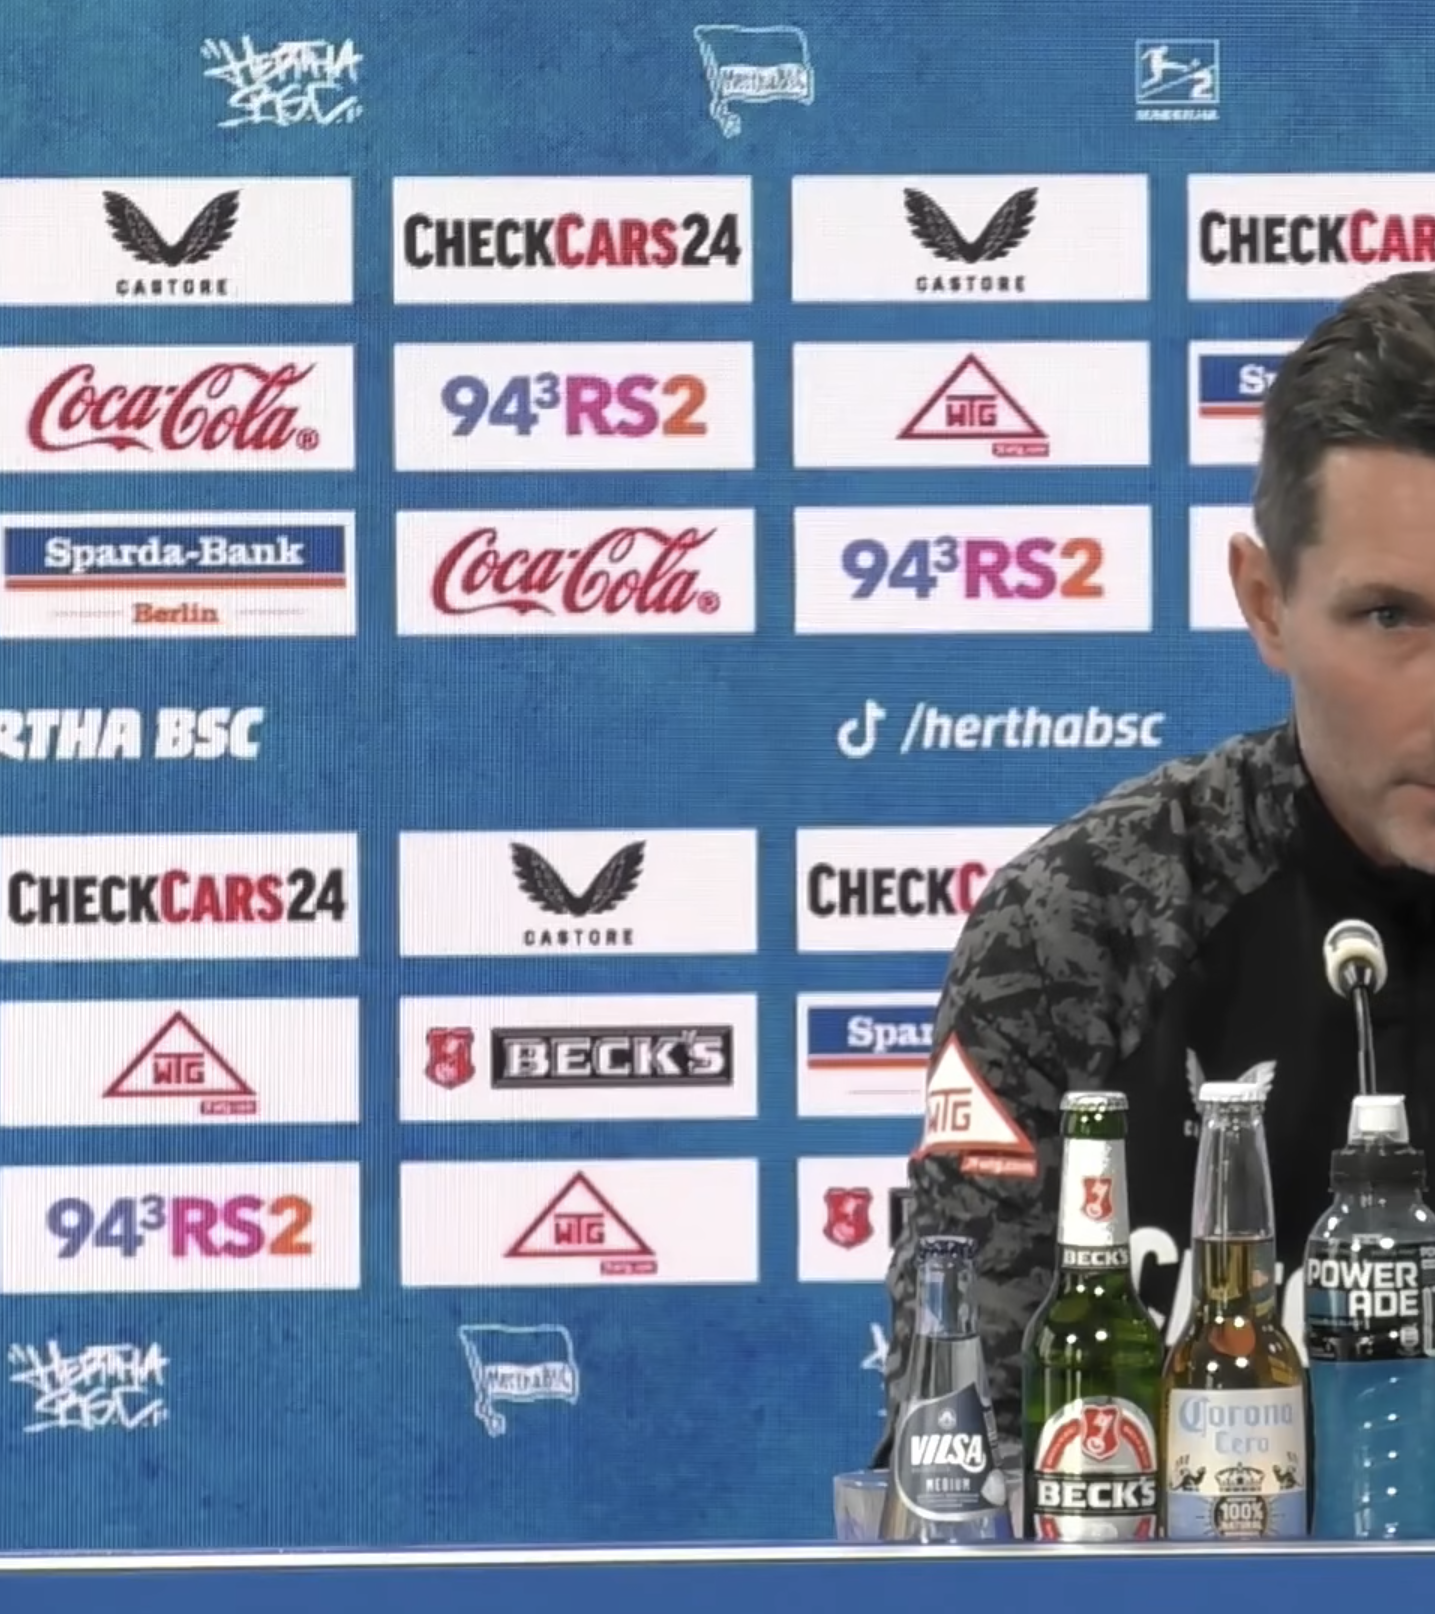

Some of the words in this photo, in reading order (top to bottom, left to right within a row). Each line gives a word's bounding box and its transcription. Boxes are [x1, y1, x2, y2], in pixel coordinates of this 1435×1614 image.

[404, 212, 742, 270] CHECKCARS24
[116, 279, 229, 296] CASTORE
[915, 275, 1025, 293] CASTORE
[945, 394, 997, 427] WTG
[44, 536, 305, 573] Sparda-Bank
[132, 601, 219, 625] Berlin
[0, 706, 142, 761] RTHA
[154, 705, 264, 760] BSC
[900, 701, 1165, 754] /herthabsc
[8, 867, 347, 926] CHECKCARS24
[523, 928, 634, 946] CASTORE
[153, 1052, 205, 1084] WTG
[503, 1029, 726, 1080] BECK'S
[554, 1213, 605, 1245] WTG
[1063, 1248, 1129, 1268] BECK'S
[1307, 1258, 1419, 1289] POWER
[1349, 1289, 1419, 1317] ADE
[1178, 1396, 1294, 1437] Corona
[910, 1432, 987, 1473] VILSA
[1214, 1430, 1270, 1455] Cero
[926, 1477, 971, 1492] MEDIUM
[1037, 1476, 1157, 1509] BECK'S
[1219, 1502, 1264, 1520] 100%
